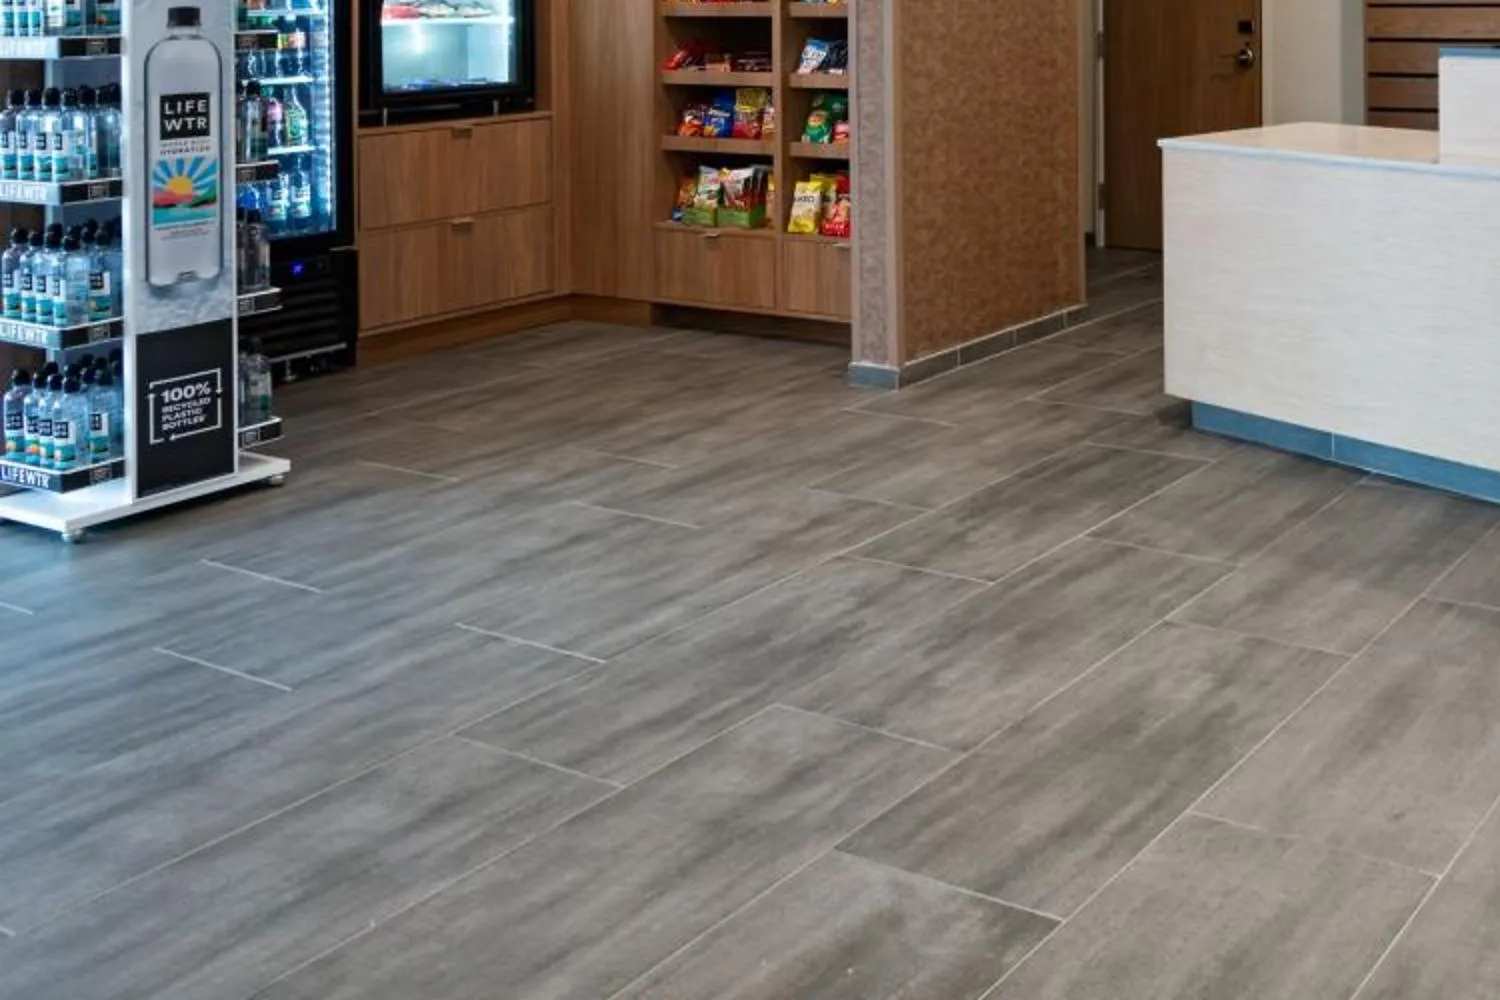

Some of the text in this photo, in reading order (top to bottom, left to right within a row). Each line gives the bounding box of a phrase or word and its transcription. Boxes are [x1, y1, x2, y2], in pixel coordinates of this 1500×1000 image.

[164, 100, 207, 115] LIFE
[164, 116, 207, 132] WTR
[161, 381, 211, 403] 100%
[1, 463, 50, 489] LIFEWTR
